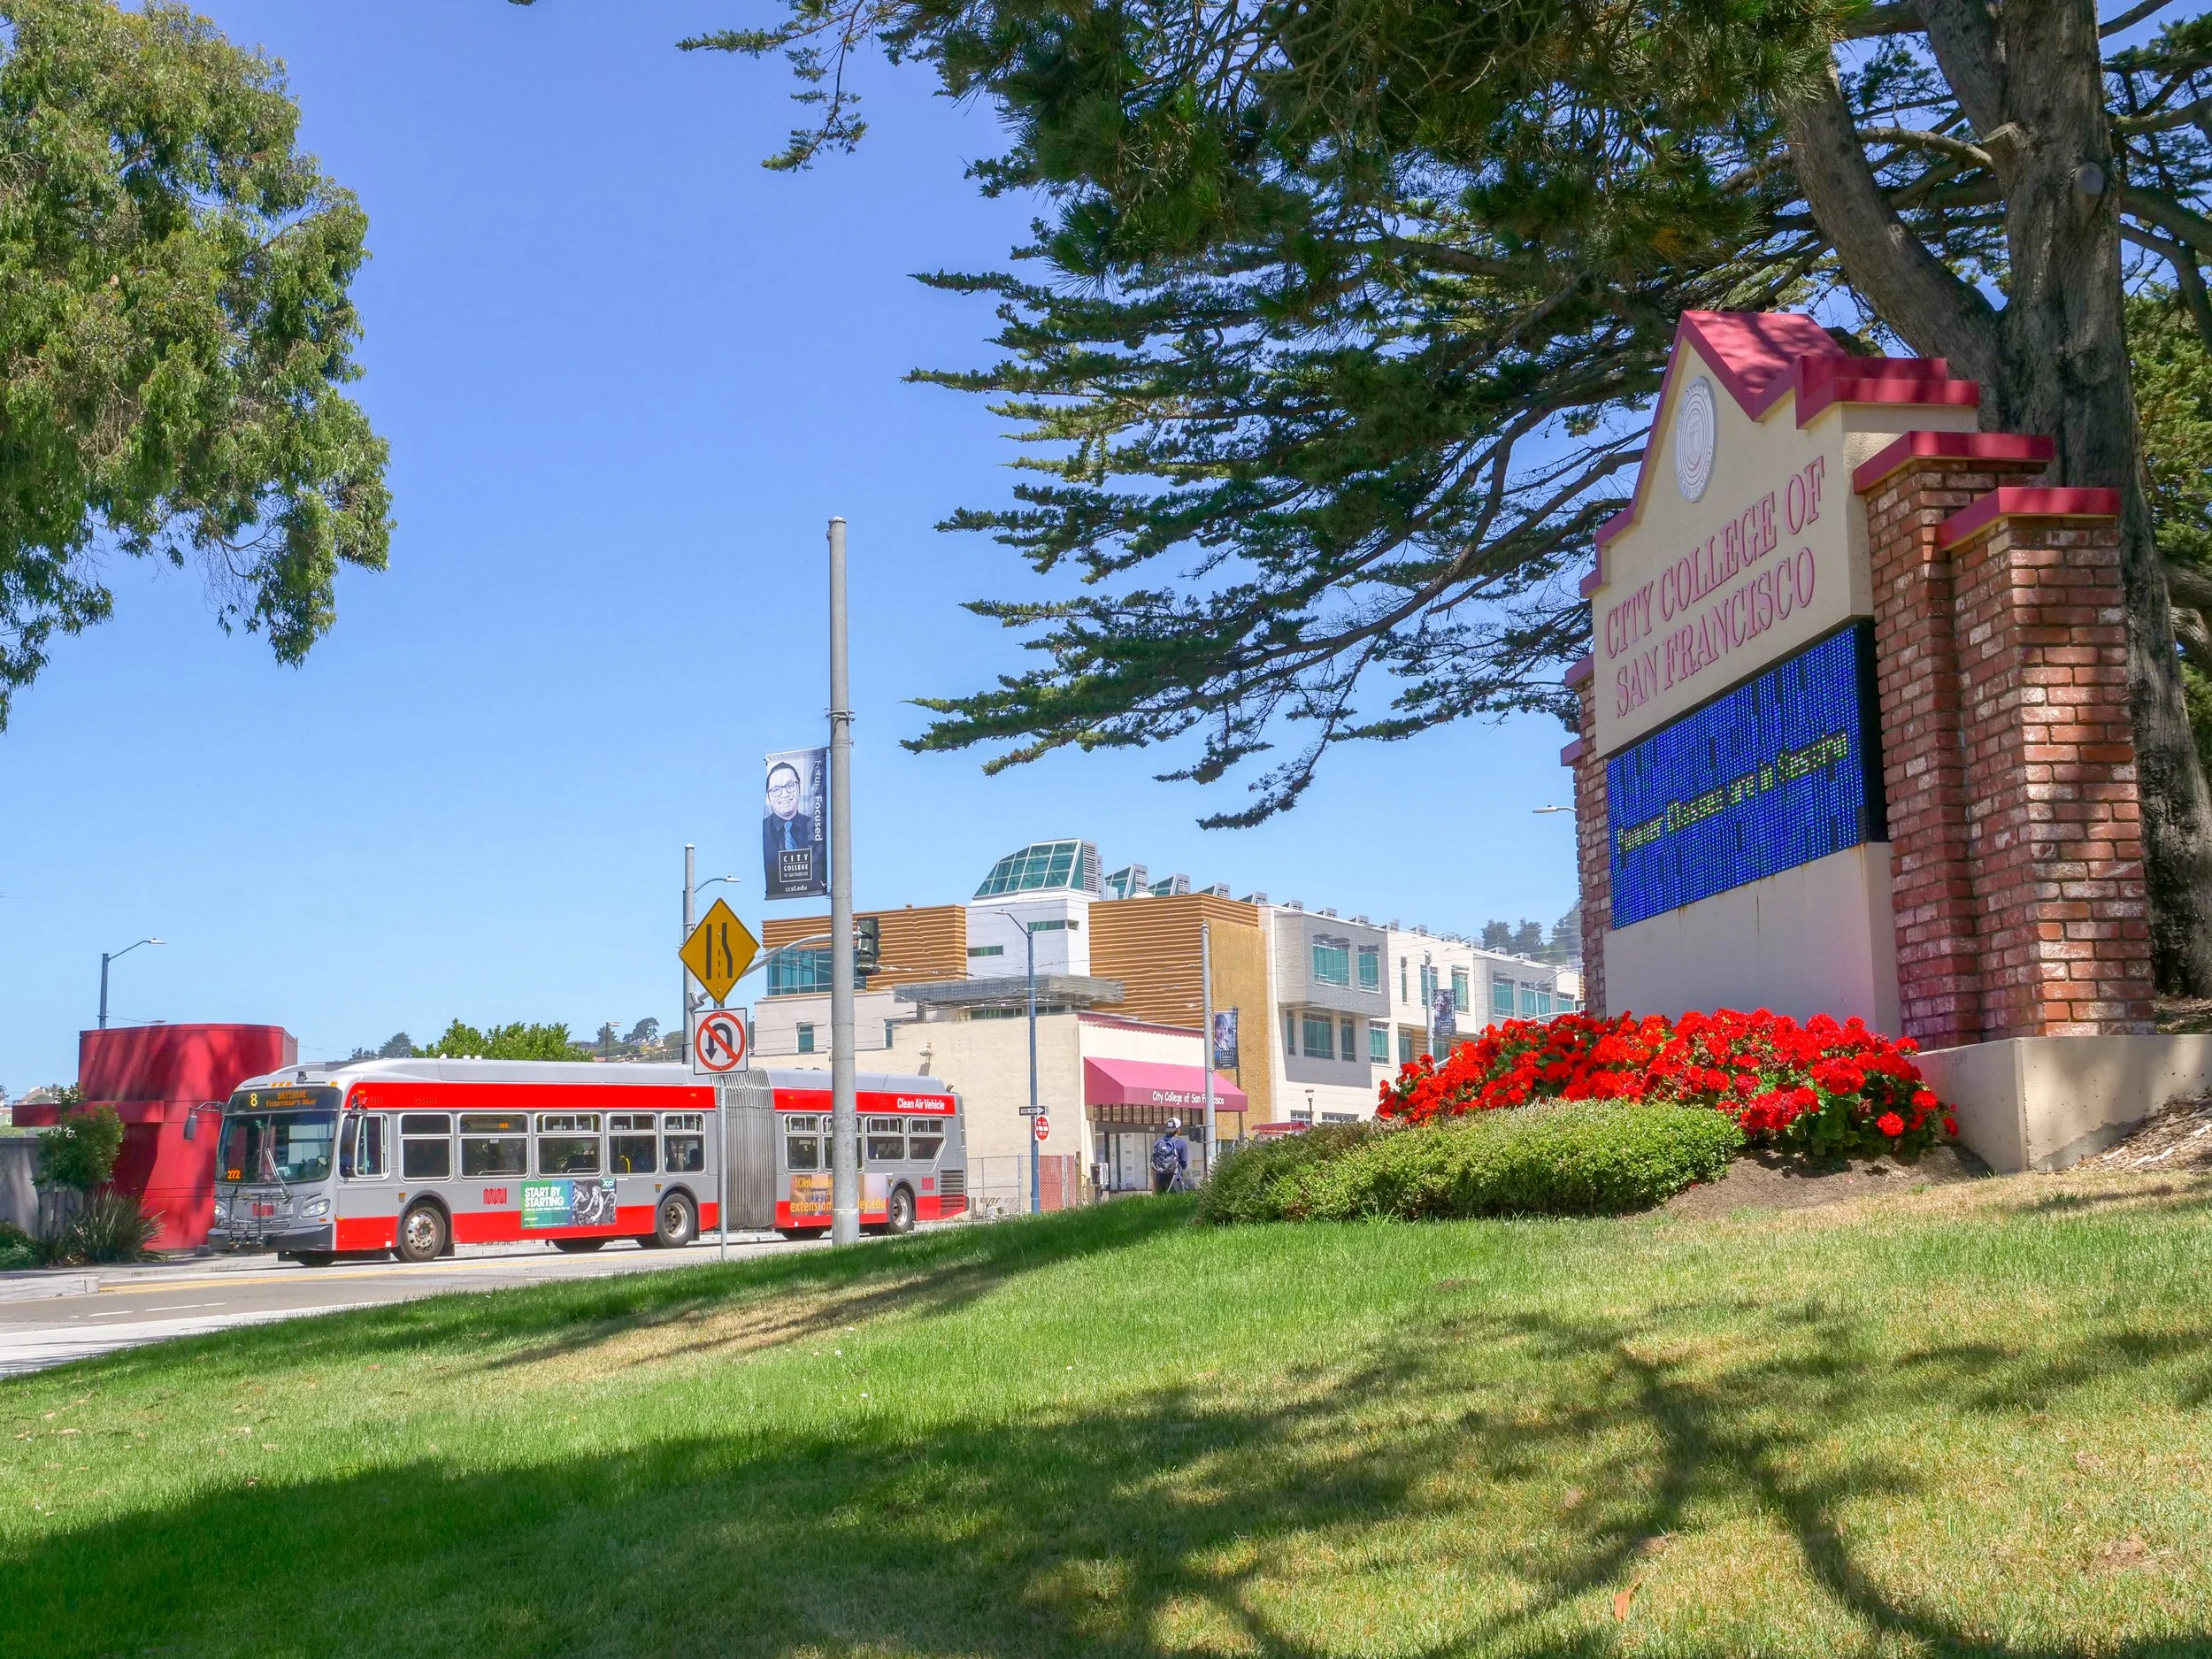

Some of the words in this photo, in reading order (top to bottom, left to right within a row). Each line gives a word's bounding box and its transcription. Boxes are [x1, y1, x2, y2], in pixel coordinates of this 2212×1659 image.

[1604, 580, 1654, 658] CITY
[1658, 491, 1778, 622] COLLEGE
[1783, 455, 1825, 535] OF
[1617, 645, 1658, 718] SAN
[1662, 547, 1816, 690] FRANCISCO
[1759, 763, 1774, 792] in
[783, 854, 809, 863] CITY
[250, 1093, 258, 1107] 8
[897, 1098, 914, 1109] Clean
[915, 1098, 924, 1110] Air
[924, 1099, 945, 1110] Vehicle
[1152, 1090, 1164, 1104] City
[1164, 1092, 1183, 1105] College
[1184, 1093, 1190, 1103] of
[1191, 1093, 1202, 1104] San
[227, 1170, 242, 1179] 272
[525, 1187, 549, 1197] START
[550, 1187, 561, 1196] BY
[524, 1196, 565, 1207] STARTING
